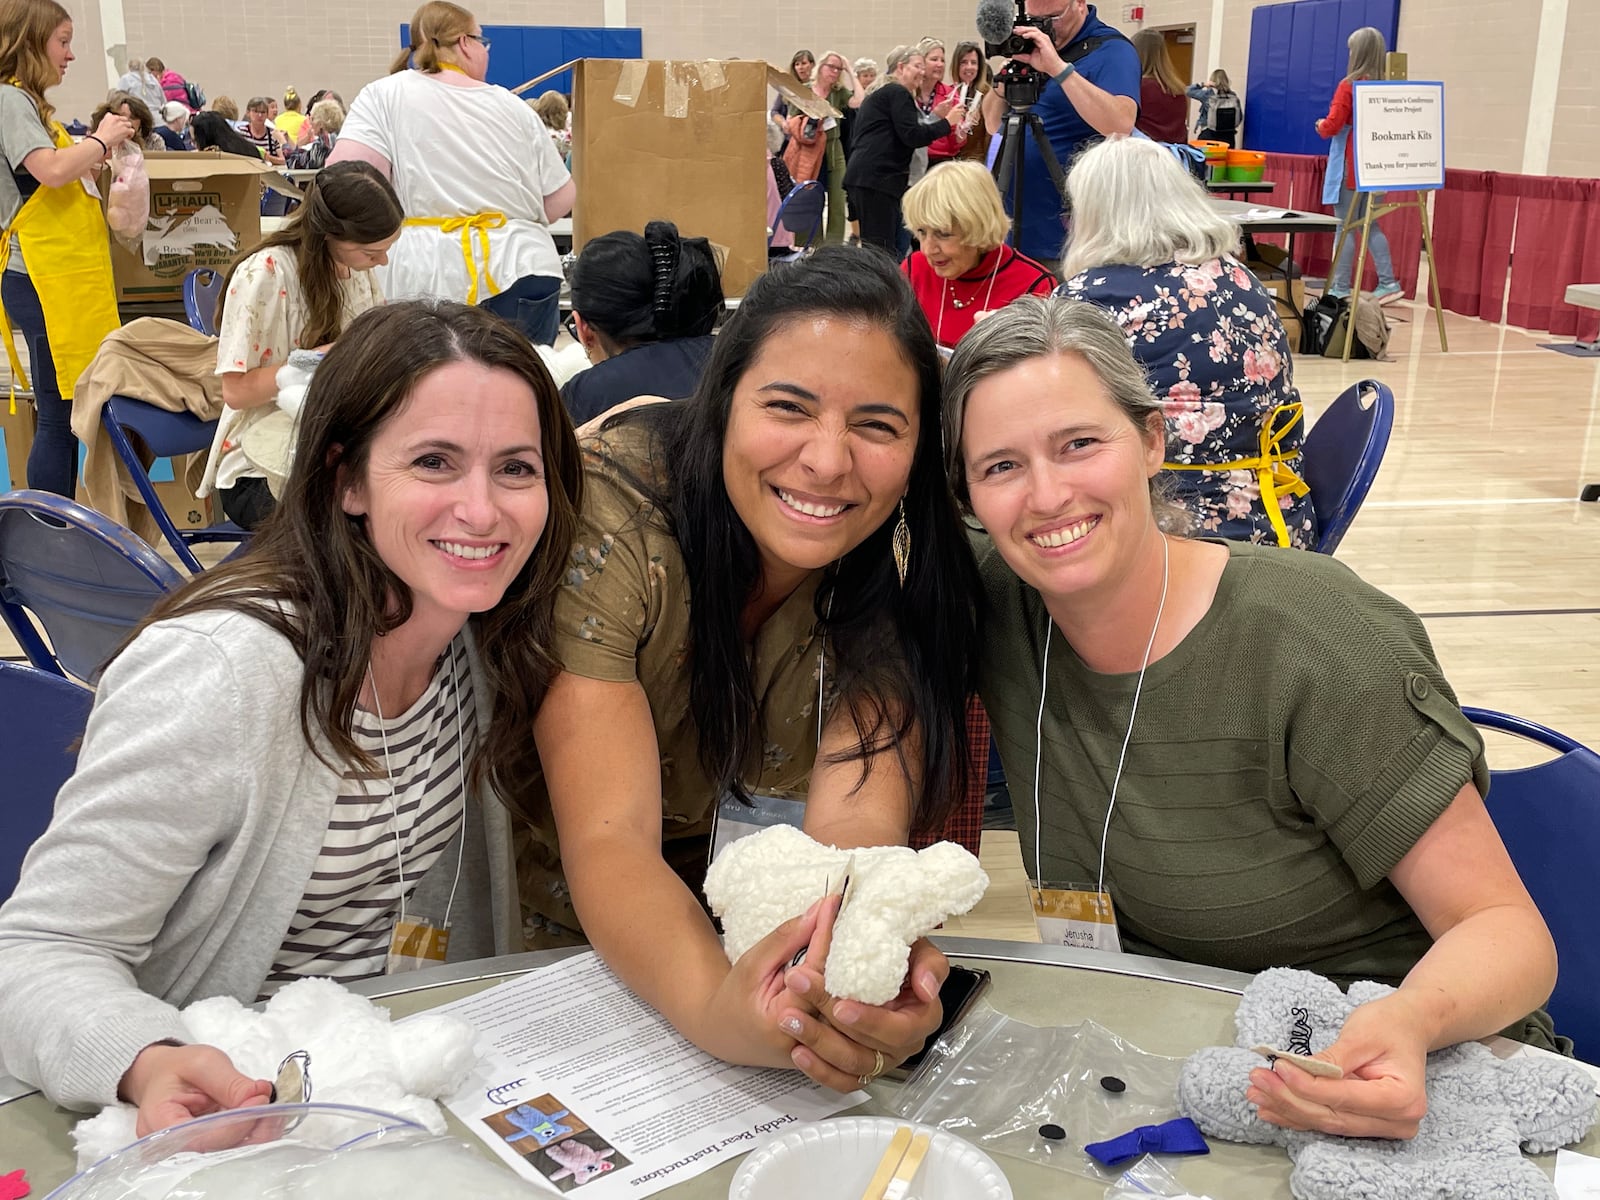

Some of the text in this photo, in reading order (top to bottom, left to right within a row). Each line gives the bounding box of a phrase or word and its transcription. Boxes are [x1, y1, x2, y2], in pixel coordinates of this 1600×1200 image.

[1404, 106, 1422, 114] Project
[1371, 131, 1432, 141] Bookmark Kits
[1364, 161, 1383, 169] Thank
[194, 216, 212, 225] Bear
[1064, 928, 1094, 942] Jerusha
[630, 1113, 798, 1187] Teddy Bear Instructions
